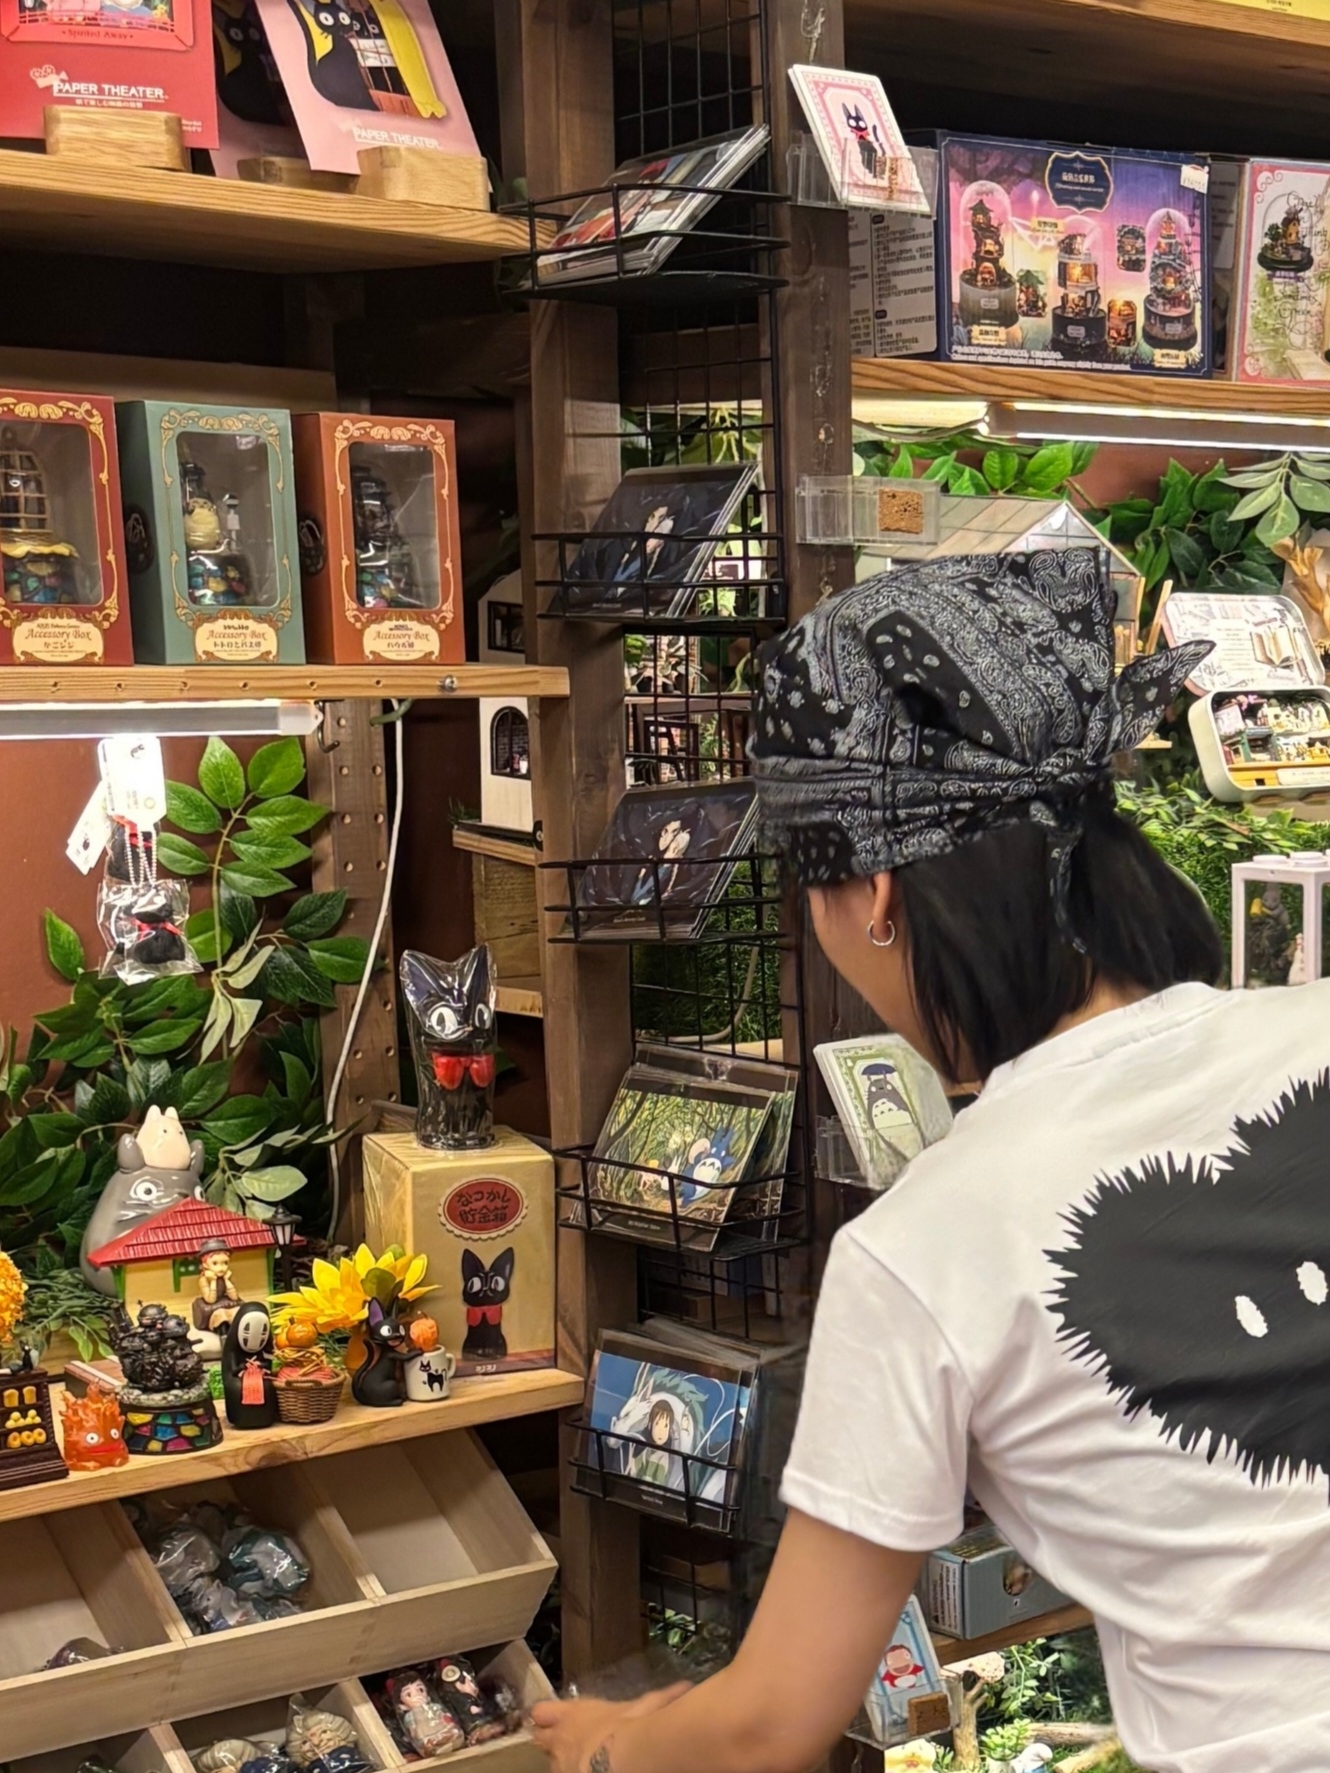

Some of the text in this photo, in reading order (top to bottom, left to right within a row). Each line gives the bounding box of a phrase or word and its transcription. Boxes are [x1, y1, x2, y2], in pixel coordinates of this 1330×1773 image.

[103, 31, 129, 41] Away
[55, 82, 164, 99] PAPER THEATER
[352, 127, 439, 149] PAPER THEATER
[25, 628, 92, 641] Accessory Box
[206, 630, 267, 641] Accessory Box
[373, 630, 430, 641] Accessory Box
[457, 1189, 510, 1208] なつかし
[459, 1205, 509, 1224] 貯金箱
